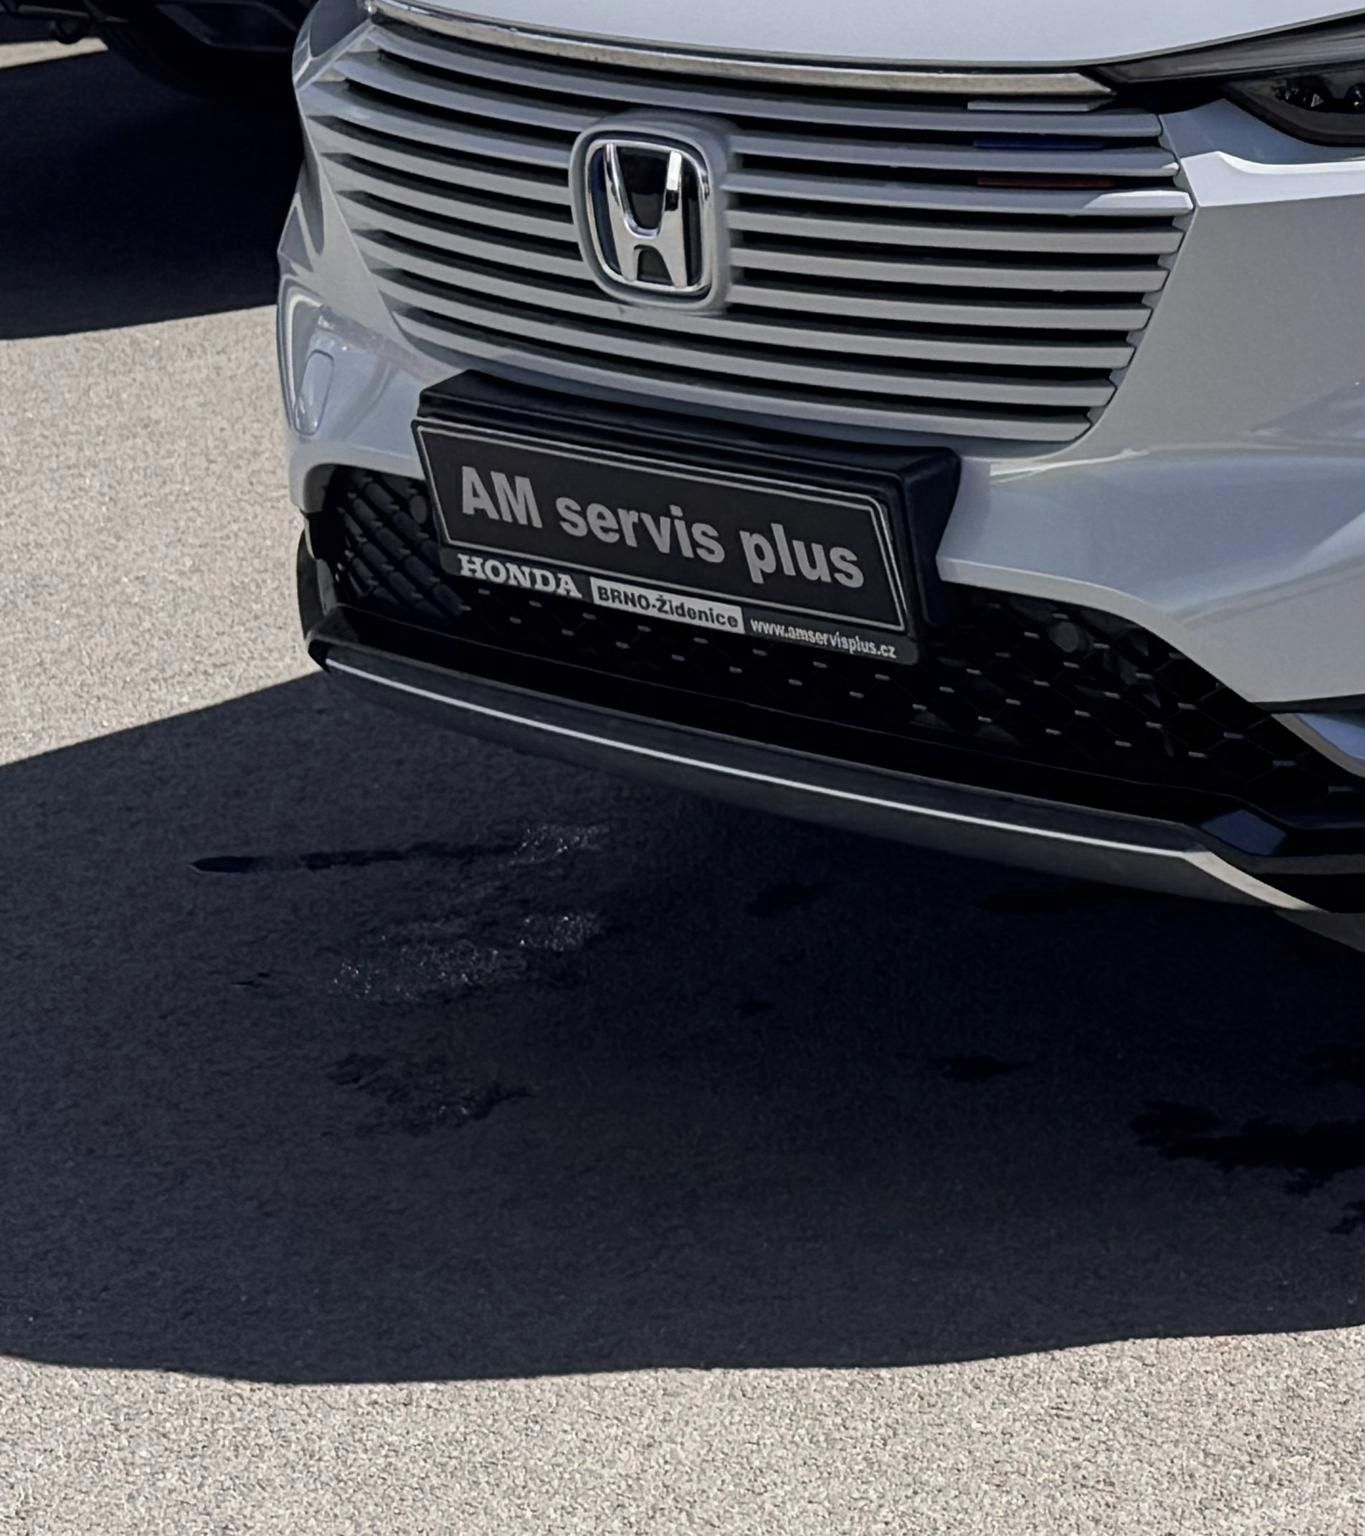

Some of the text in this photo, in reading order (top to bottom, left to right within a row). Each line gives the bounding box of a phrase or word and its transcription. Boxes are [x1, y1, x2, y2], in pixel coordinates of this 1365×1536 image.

[461, 465, 864, 588] AM servis plus
[457, 553, 897, 658] HONDA BRNO-Židenice www.amservisplus.cz
